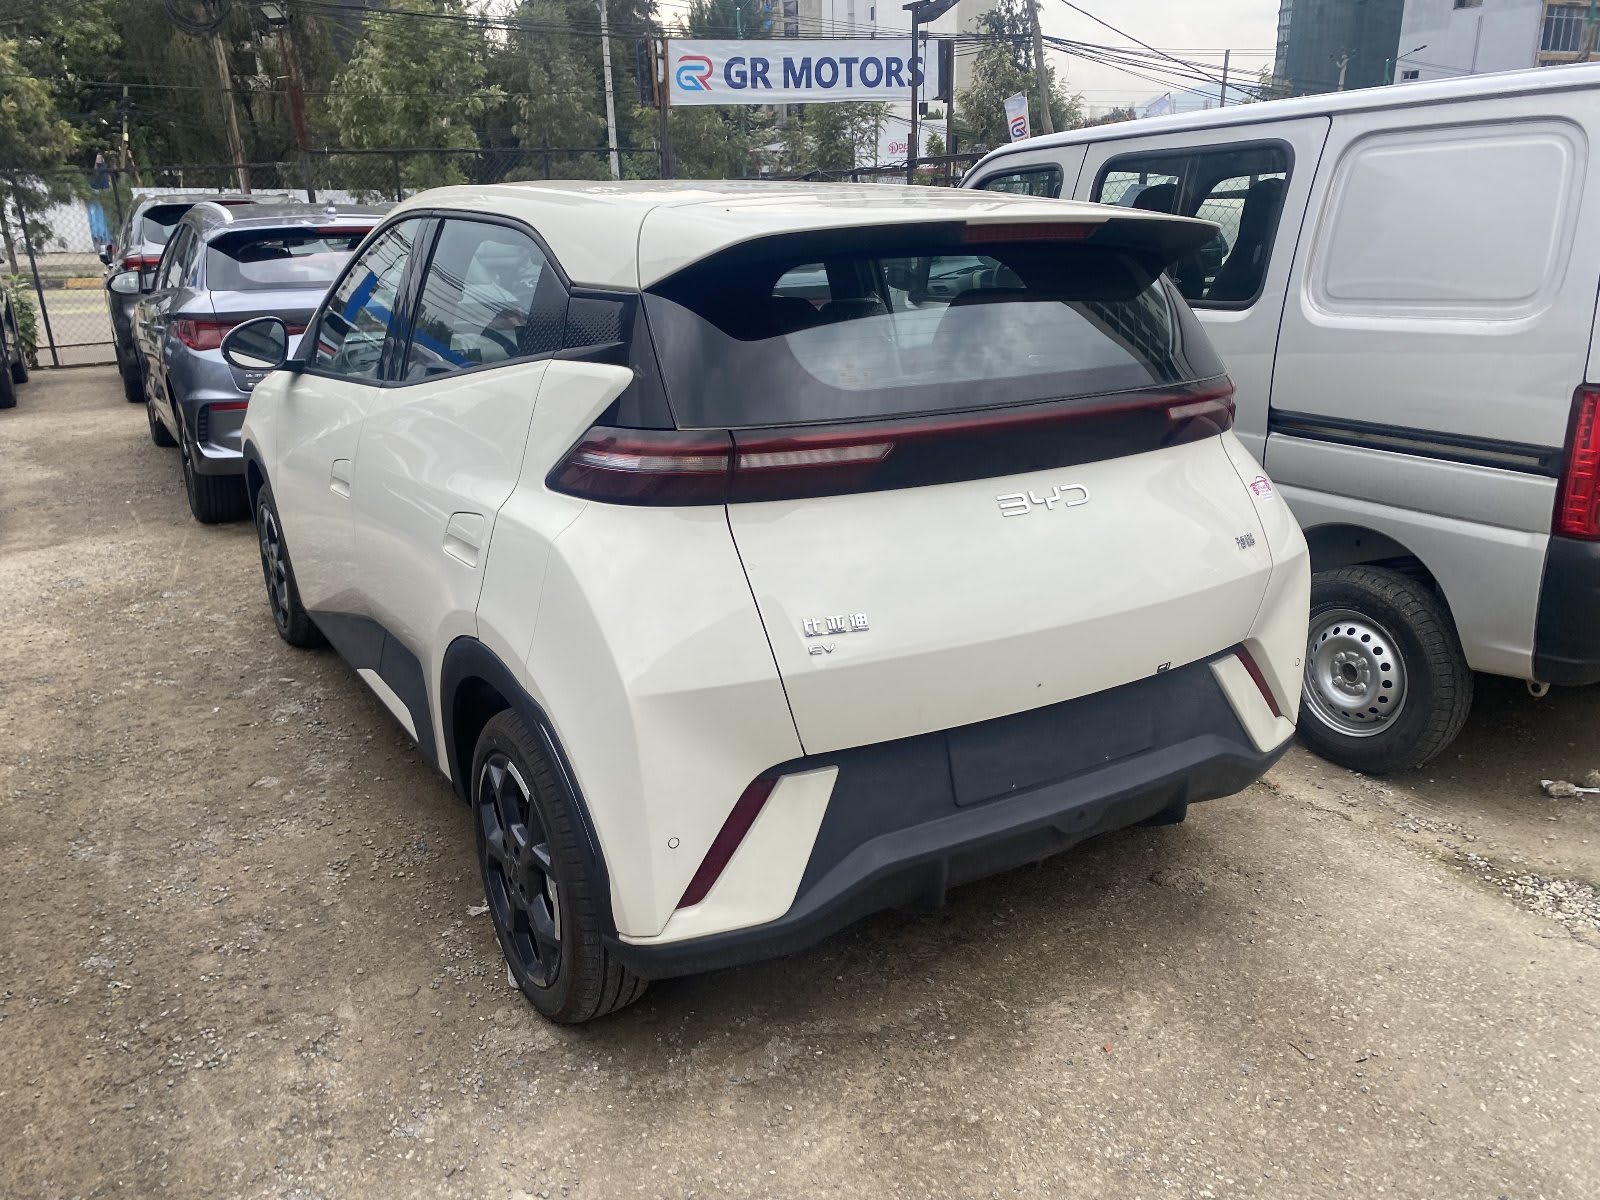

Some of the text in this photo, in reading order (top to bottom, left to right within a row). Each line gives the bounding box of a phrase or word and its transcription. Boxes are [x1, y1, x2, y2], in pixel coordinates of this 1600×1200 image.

[723, 56, 772, 89] GR
[783, 56, 924, 88] MOTORS
[997, 483, 1090, 517] BYD
[802, 612, 869, 637] 比亚迪
[808, 643, 835, 655] EV
